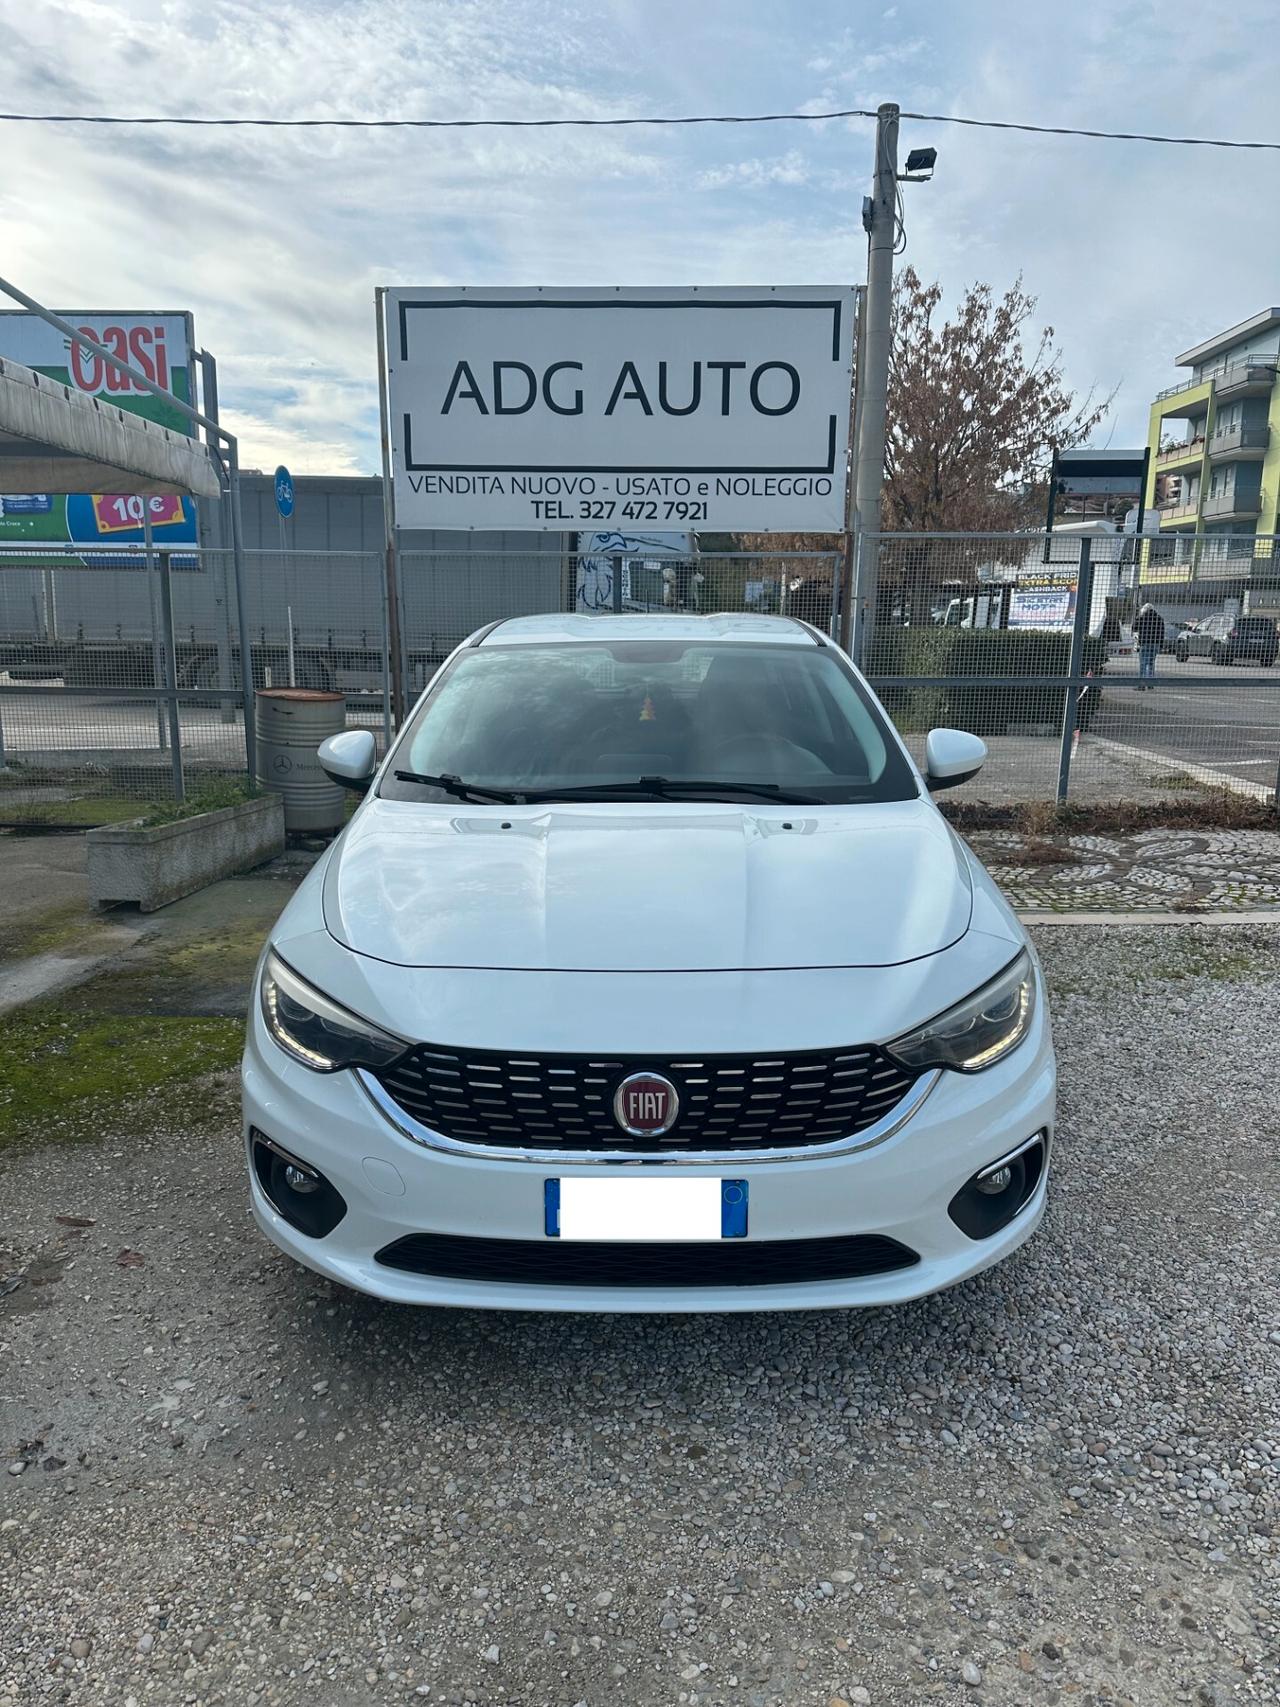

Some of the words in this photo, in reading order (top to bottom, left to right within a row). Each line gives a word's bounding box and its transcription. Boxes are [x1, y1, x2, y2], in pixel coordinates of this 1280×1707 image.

[440, 360, 584, 416] ADG
[604, 361, 801, 417] AUTO
[407, 475, 505, 495] VENDITA
[511, 476, 596, 496] NUOVO
[615, 477, 691, 496] USATO
[697, 482, 709, 496] e
[715, 477, 833, 497] NOLEGGIO
[530, 500, 575, 520] TEL.
[579, 500, 617, 520] 327
[621, 500, 658, 520] 472
[662, 501, 708, 521] 7921
[1018, 579, 1050, 587] EXTRA
[629, 1092, 666, 1120] FIAT
